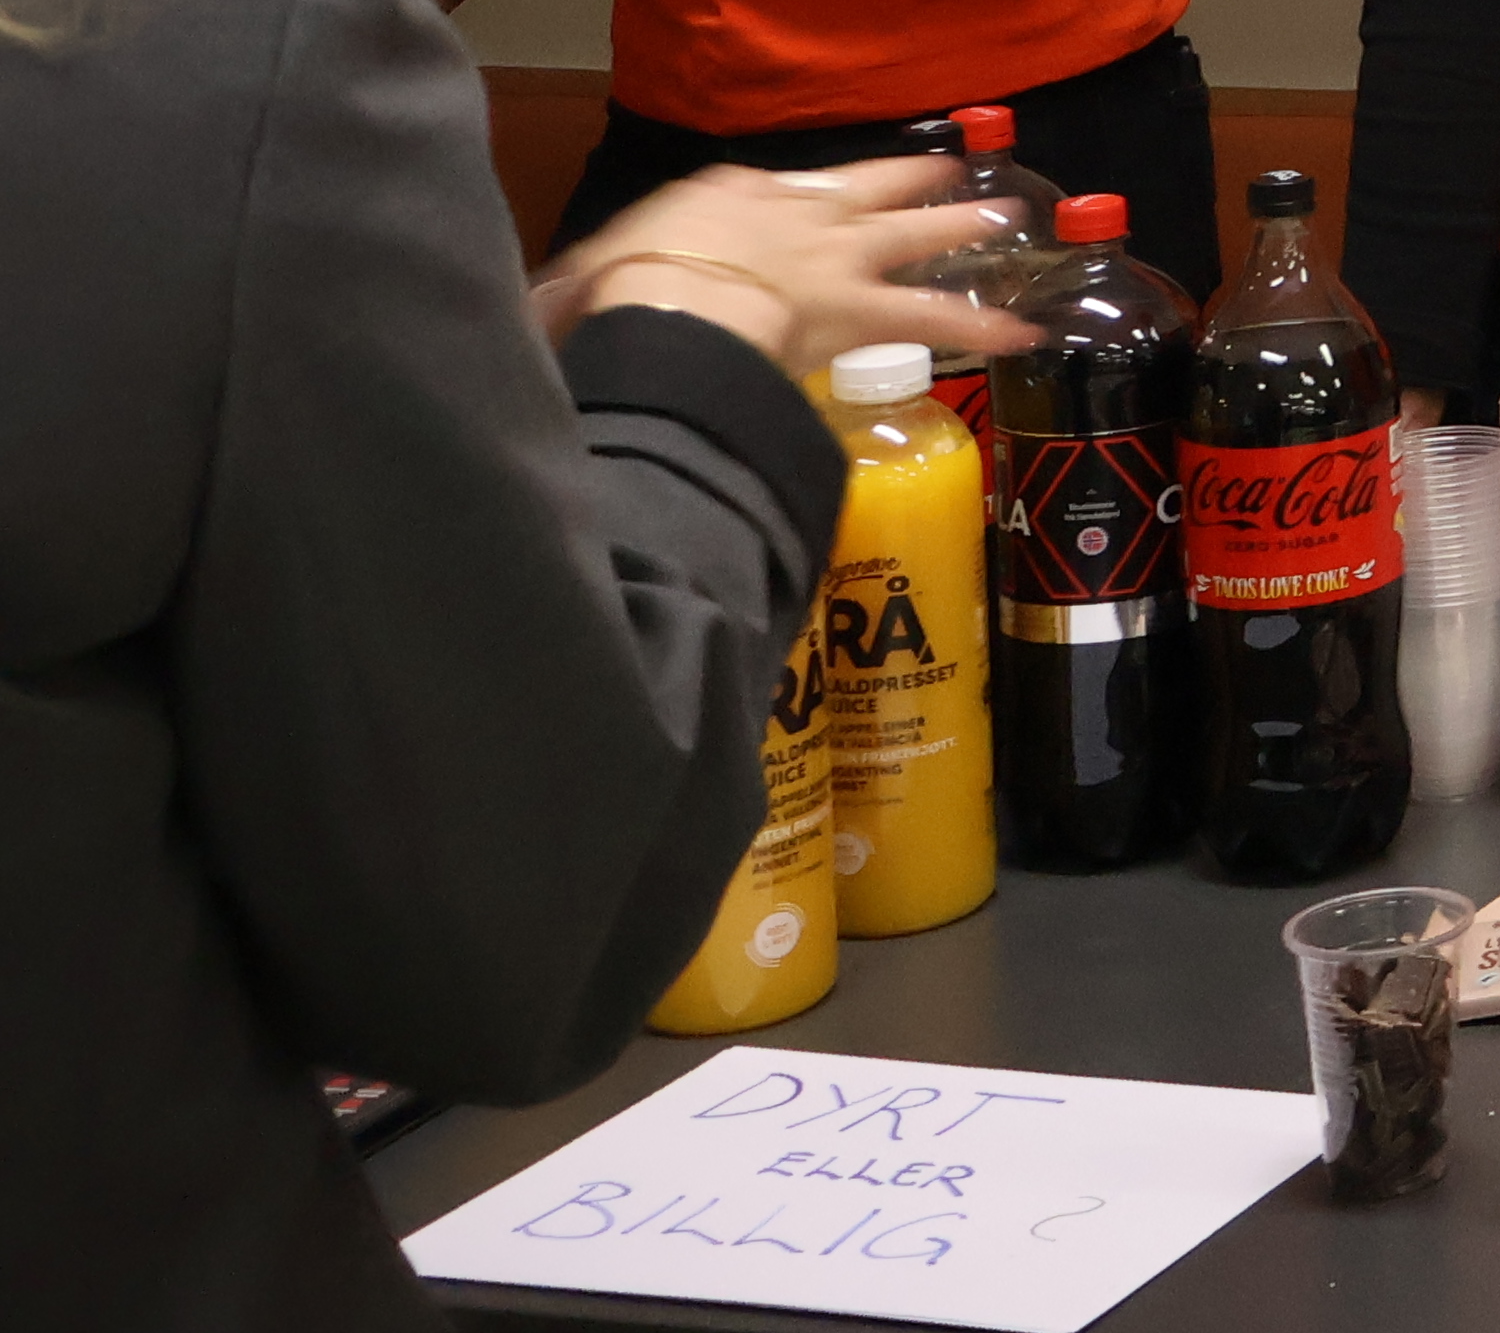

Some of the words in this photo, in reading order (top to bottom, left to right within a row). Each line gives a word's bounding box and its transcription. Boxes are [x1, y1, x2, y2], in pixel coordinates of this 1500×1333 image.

[1211, 575, 1259, 600] TACOS
[1259, 574, 1304, 600] LOVE
[1305, 565, 1351, 596] COKE
[830, 661, 958, 695] ALDPRESSET
[831, 698, 878, 714] UICE
[689, 1070, 1067, 1142] DYRT
[757, 1150, 978, 1199] ELLER
[510, 1179, 969, 1267] BILLIG
